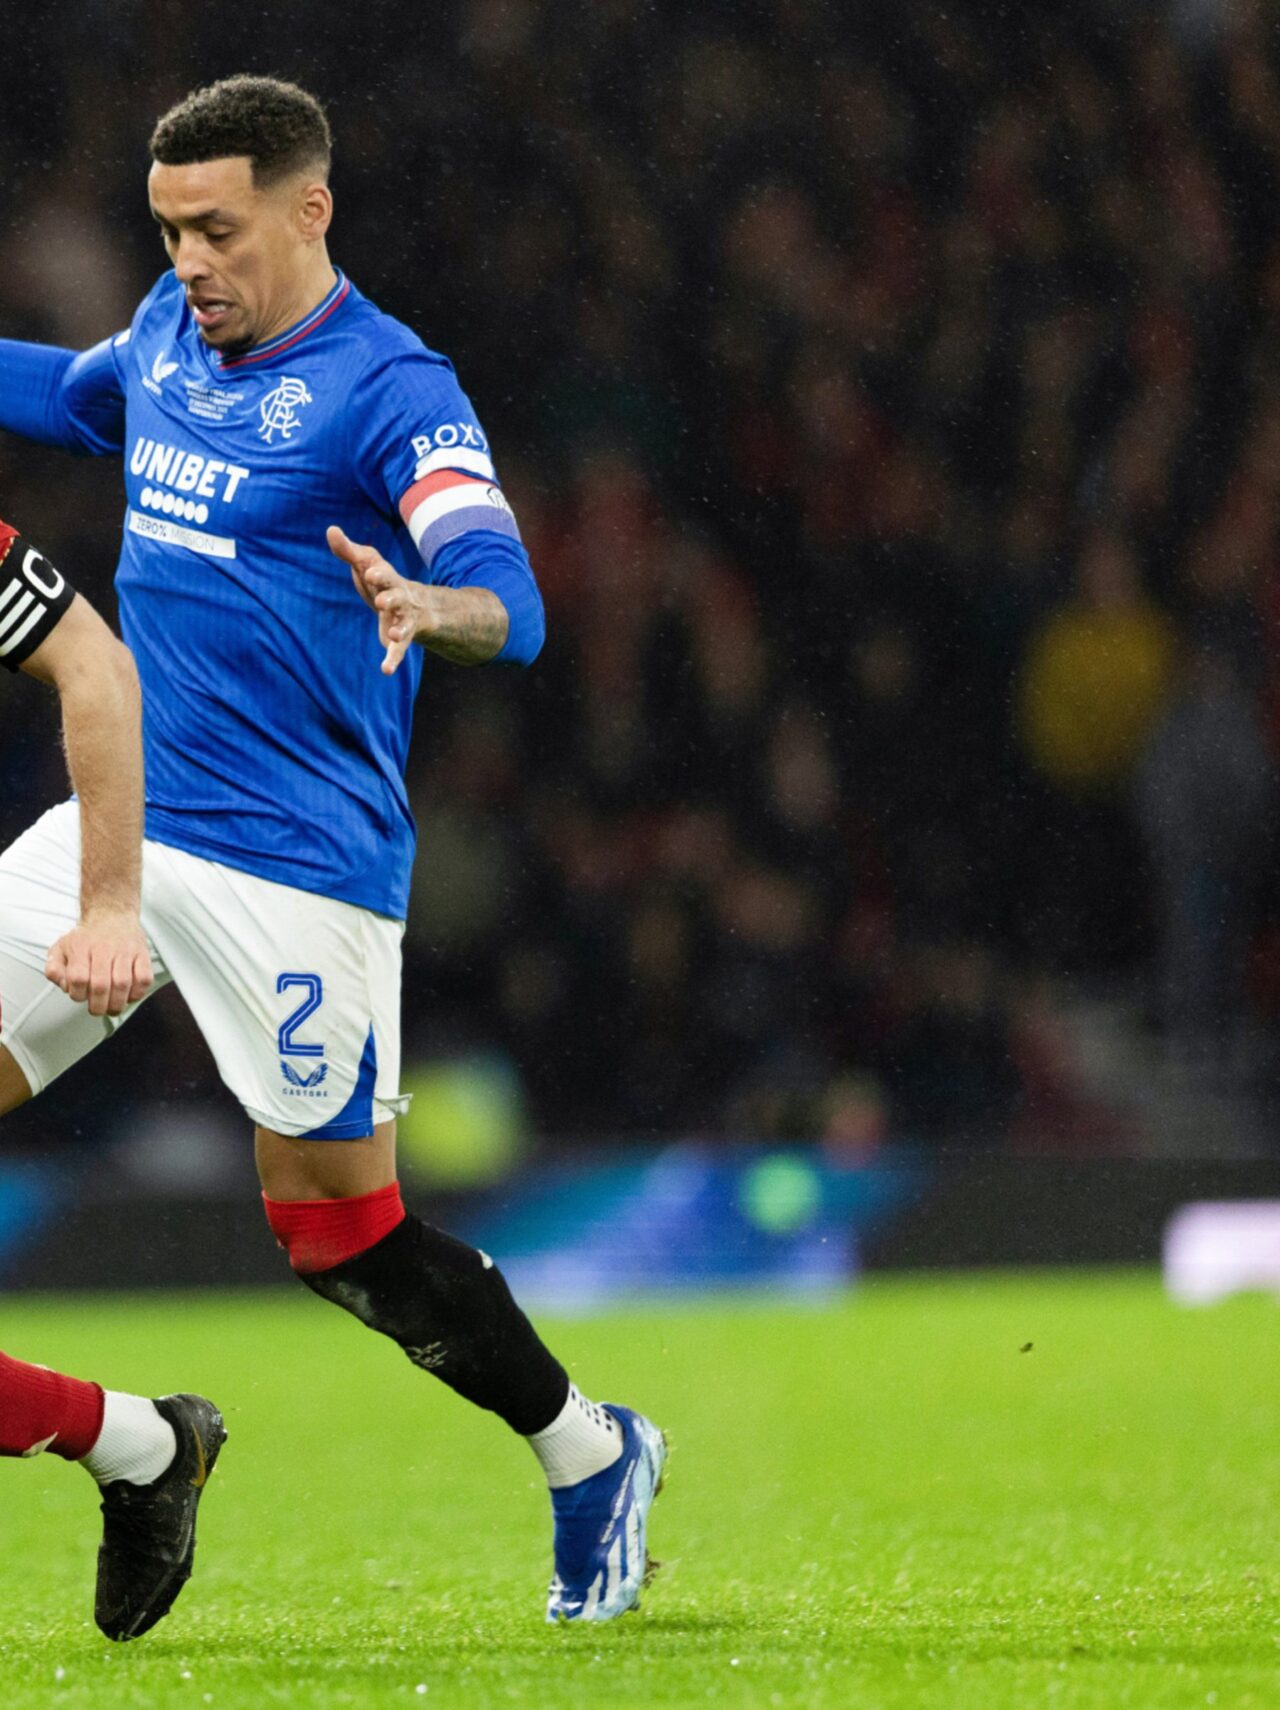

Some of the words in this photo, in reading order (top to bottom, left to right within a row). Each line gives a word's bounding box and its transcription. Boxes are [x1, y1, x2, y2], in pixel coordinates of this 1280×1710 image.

[130, 437, 250, 503] UNIBET
[22, 548, 65, 599] C
[276, 973, 324, 1057] 2
[282, 1087, 328, 1097] CASTORE
